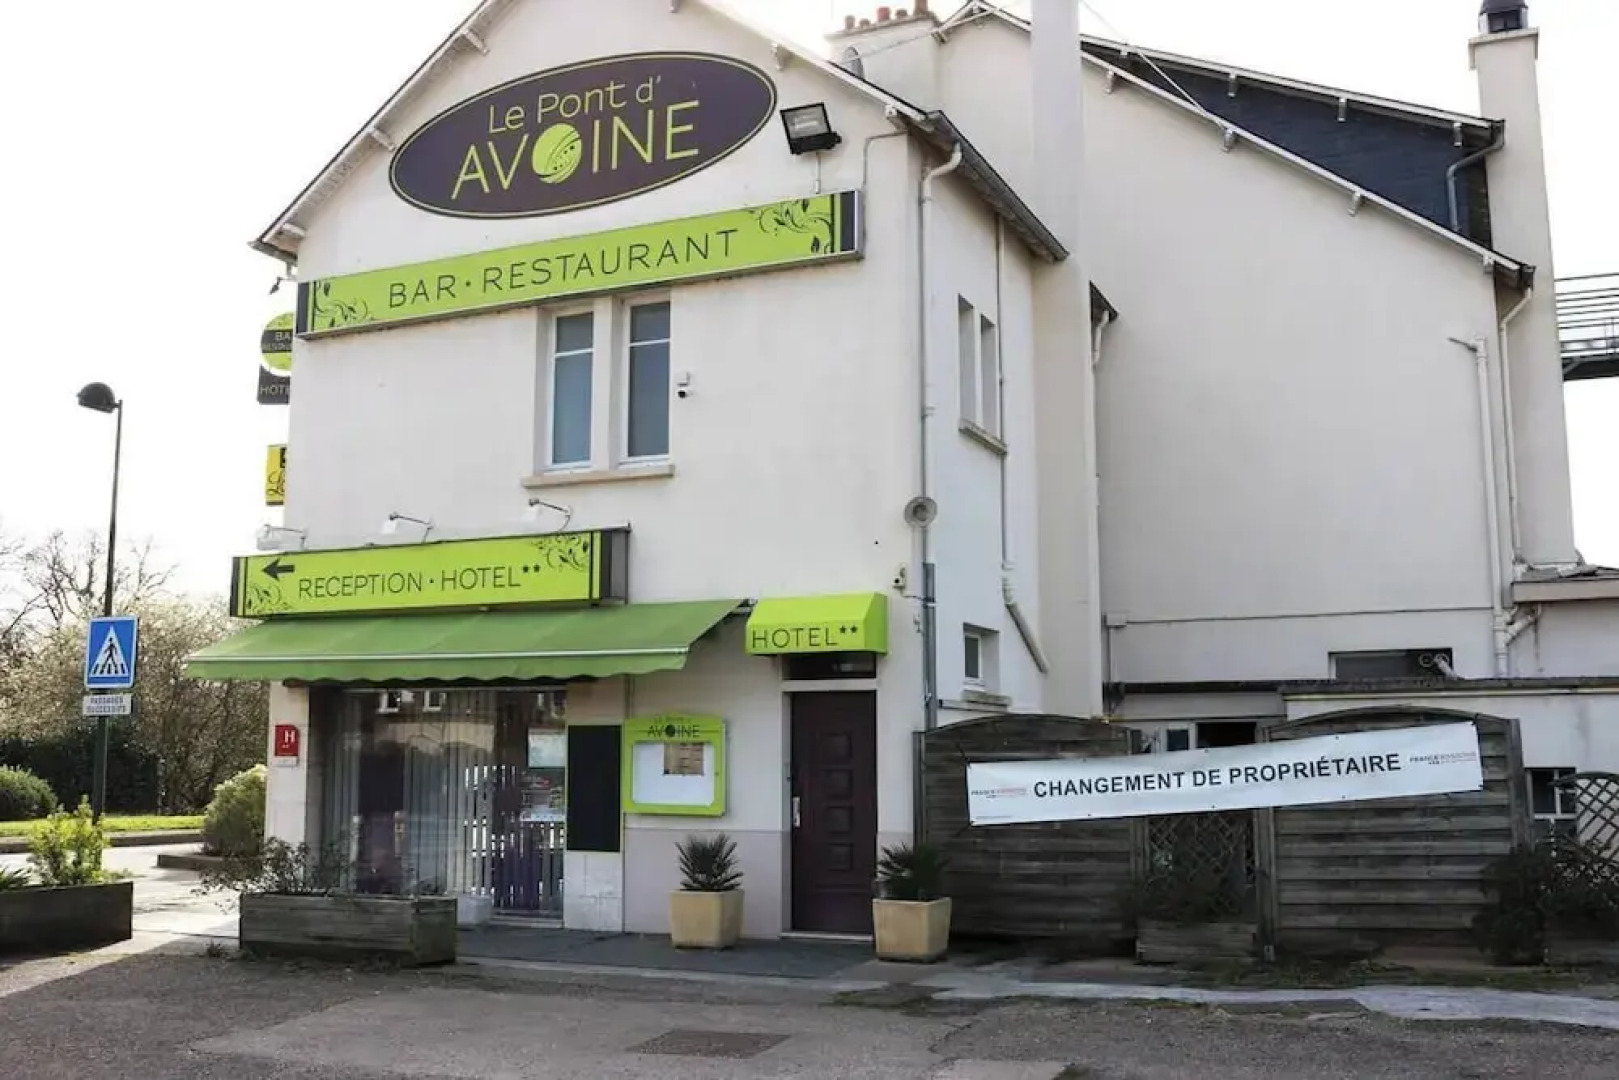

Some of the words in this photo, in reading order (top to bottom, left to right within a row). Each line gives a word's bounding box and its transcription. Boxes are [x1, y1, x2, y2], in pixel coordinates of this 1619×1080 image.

[488, 104, 525, 134] Le
[537, 80, 628, 124] Pont
[635, 75, 662, 103] d'
[451, 100, 700, 200] AVOINE
[389, 273, 457, 308] BAR
[482, 228, 738, 294] RESTAURANT
[298, 571, 423, 600] RECEPTION
[647, 723, 701, 738] AVOINE
[1034, 771, 1186, 798] CHANGEMENT
[1192, 769, 1222, 787] DE
[1229, 753, 1402, 784] PROPRIÉTAIRE
